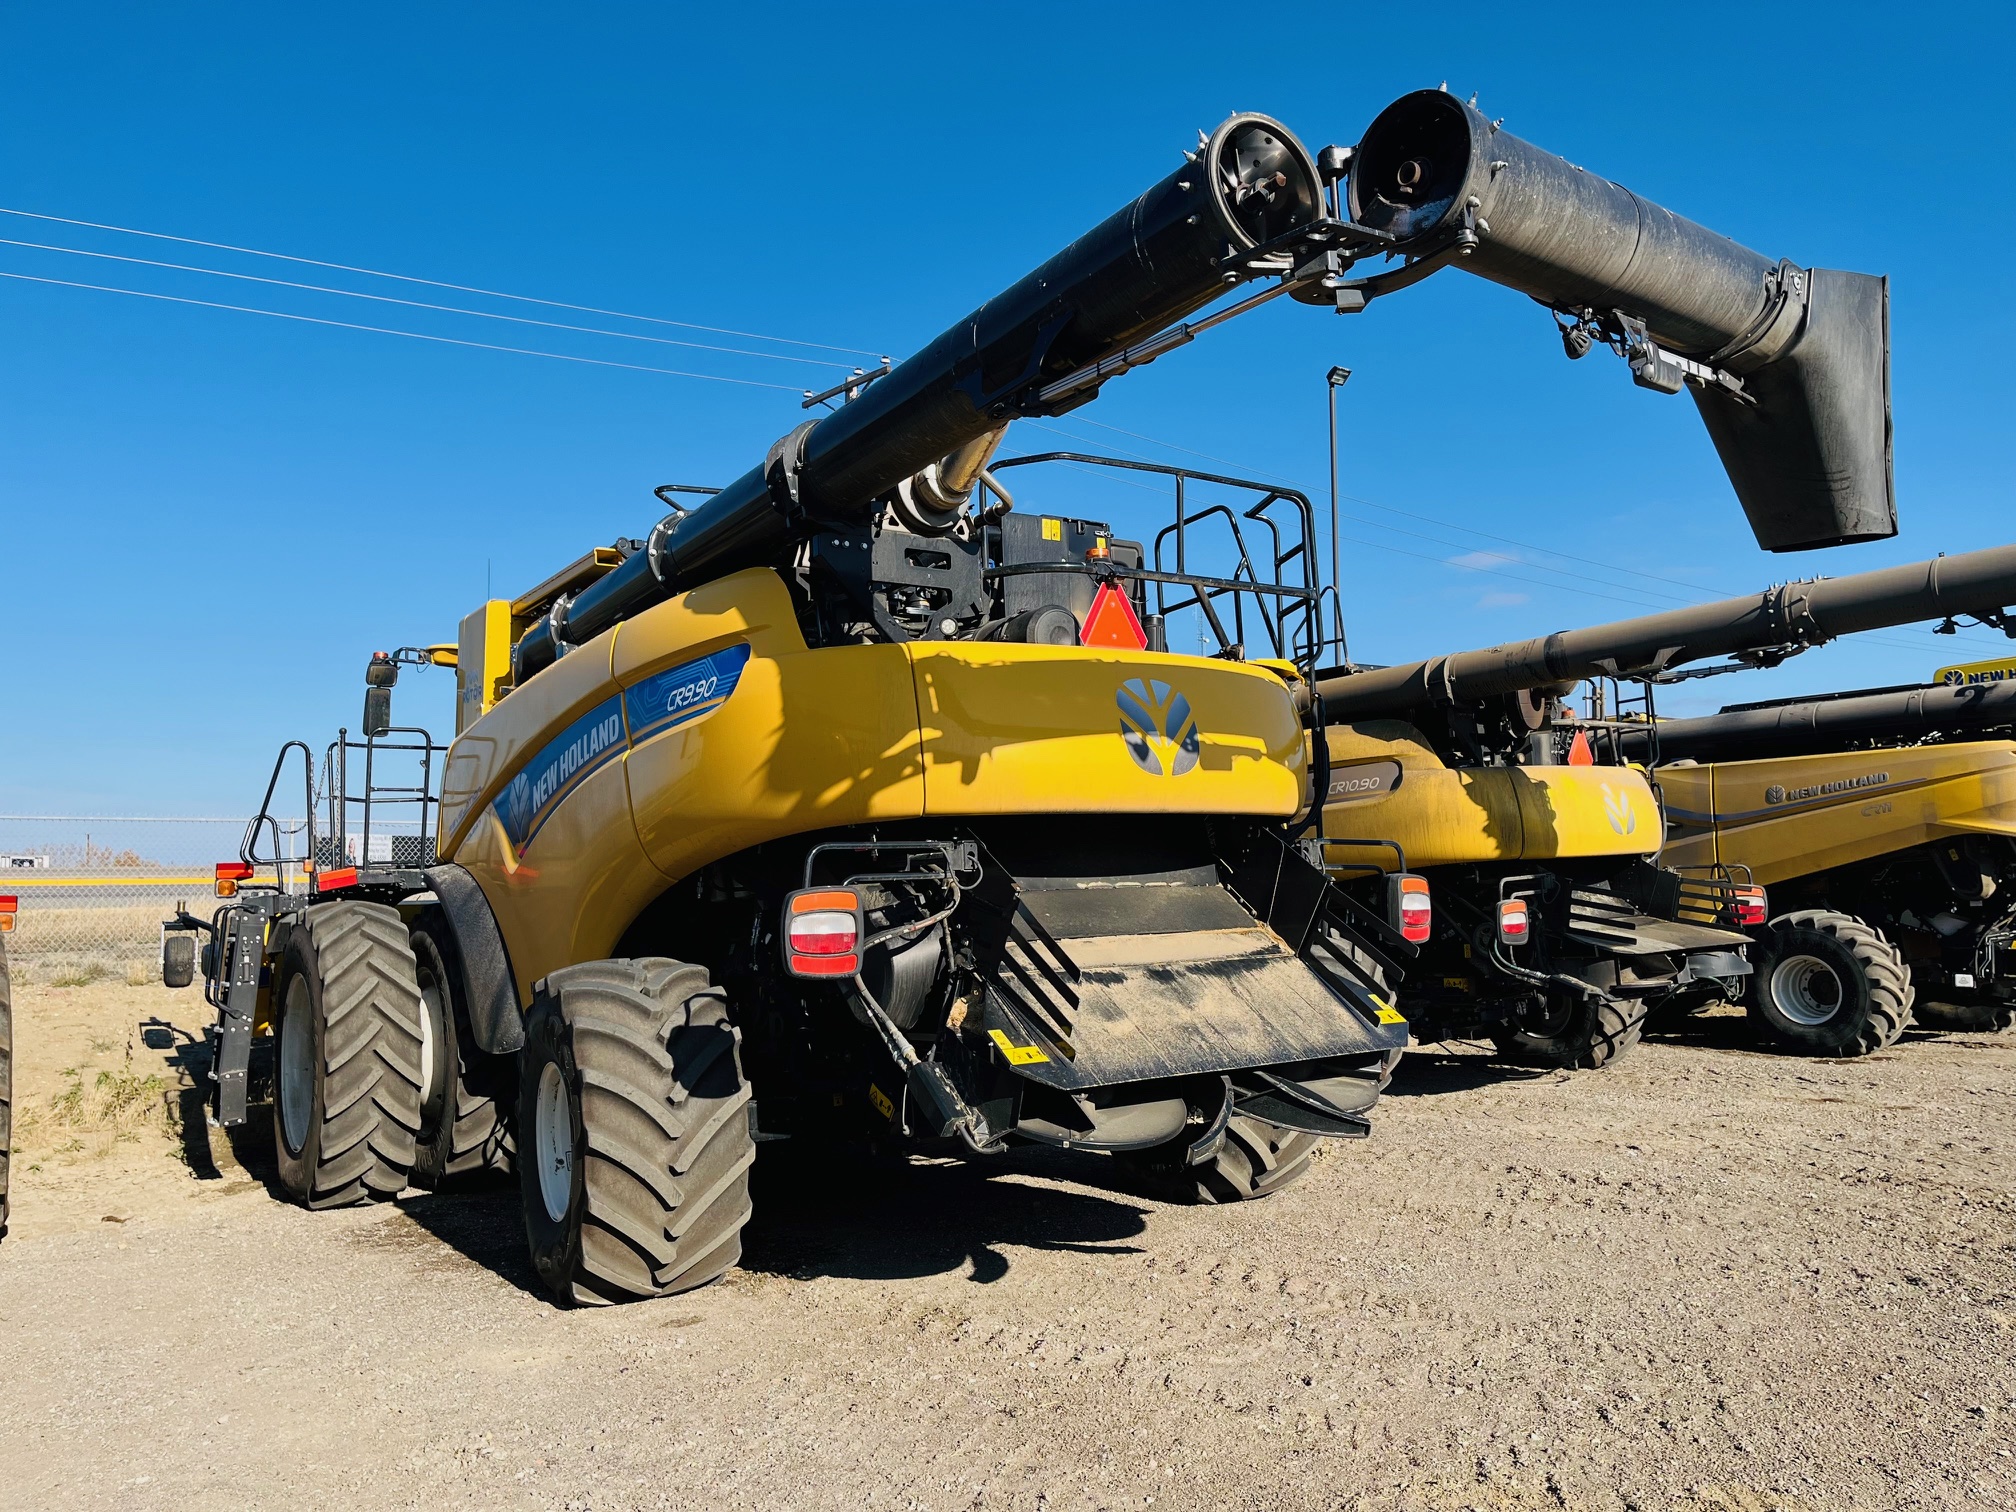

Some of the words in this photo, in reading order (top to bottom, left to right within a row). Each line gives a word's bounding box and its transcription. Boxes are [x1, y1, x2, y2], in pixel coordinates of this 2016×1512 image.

[1968, 668, 2006, 684] NEW
[667, 676, 718, 712] CR9.90
[532, 760, 558, 813] NEW
[560, 713, 620, 783] HOLLAND
[1328, 776, 1380, 794] CR10.90
[1789, 784, 1822, 800] NEW
[1824, 771, 1889, 794] HOLLAND
